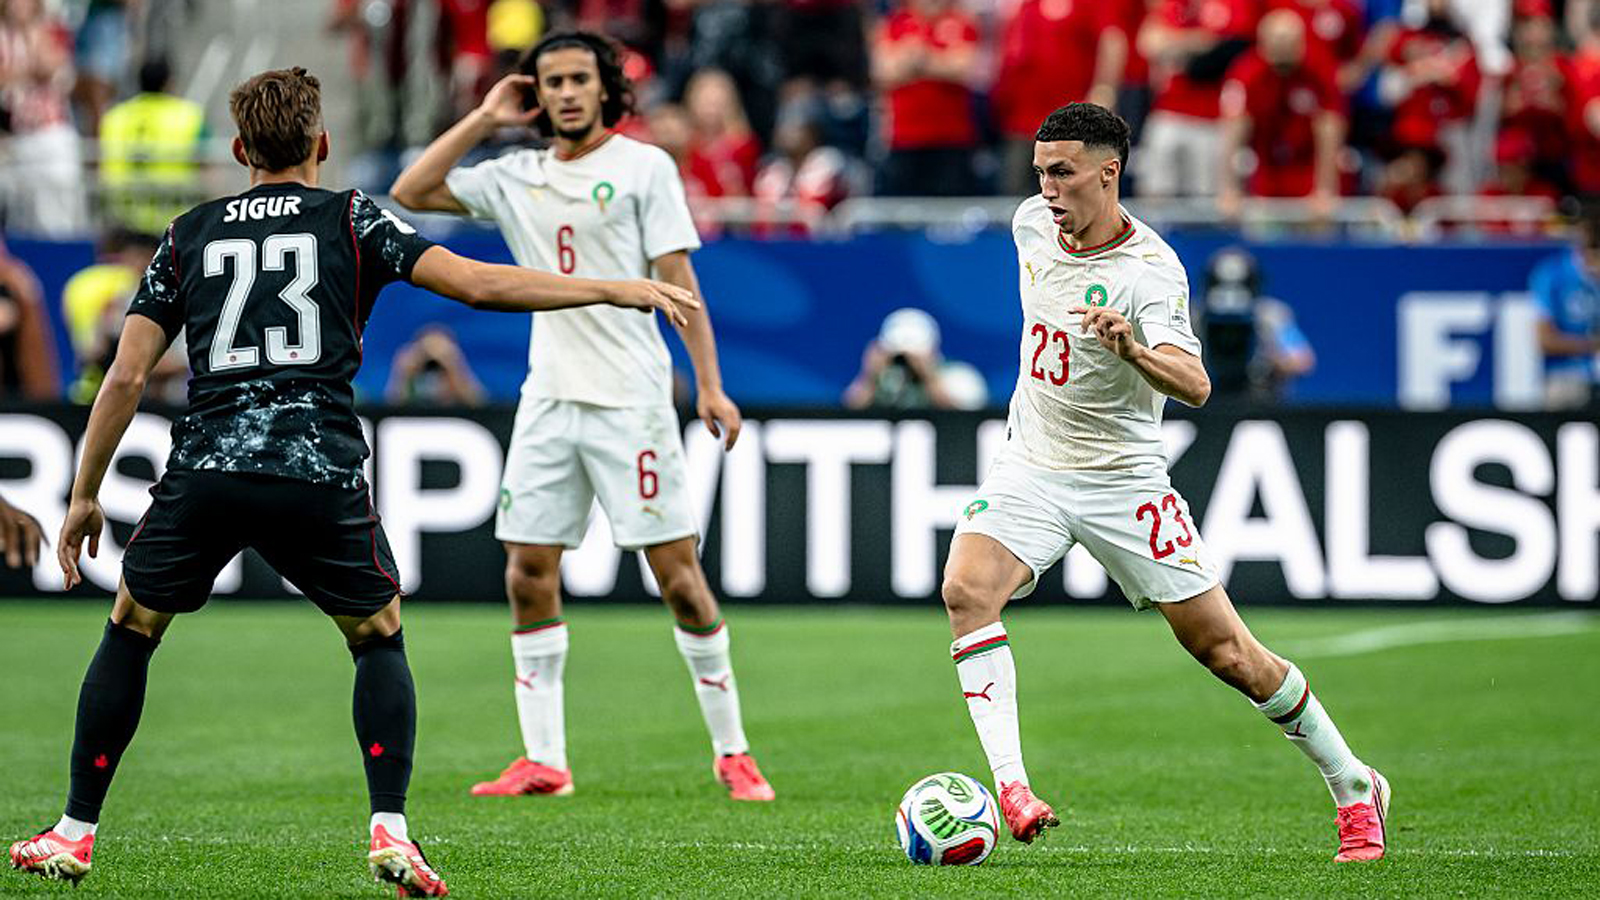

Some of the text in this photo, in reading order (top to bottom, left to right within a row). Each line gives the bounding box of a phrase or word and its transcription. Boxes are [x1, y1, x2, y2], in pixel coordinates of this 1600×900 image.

[223, 195, 303, 223] SIGUR
[556, 224, 576, 275] 6
[203, 232, 322, 373] 23
[1029, 323, 1071, 387] 23
[637, 450, 660, 500] 6
[1135, 492, 1194, 561] 23
